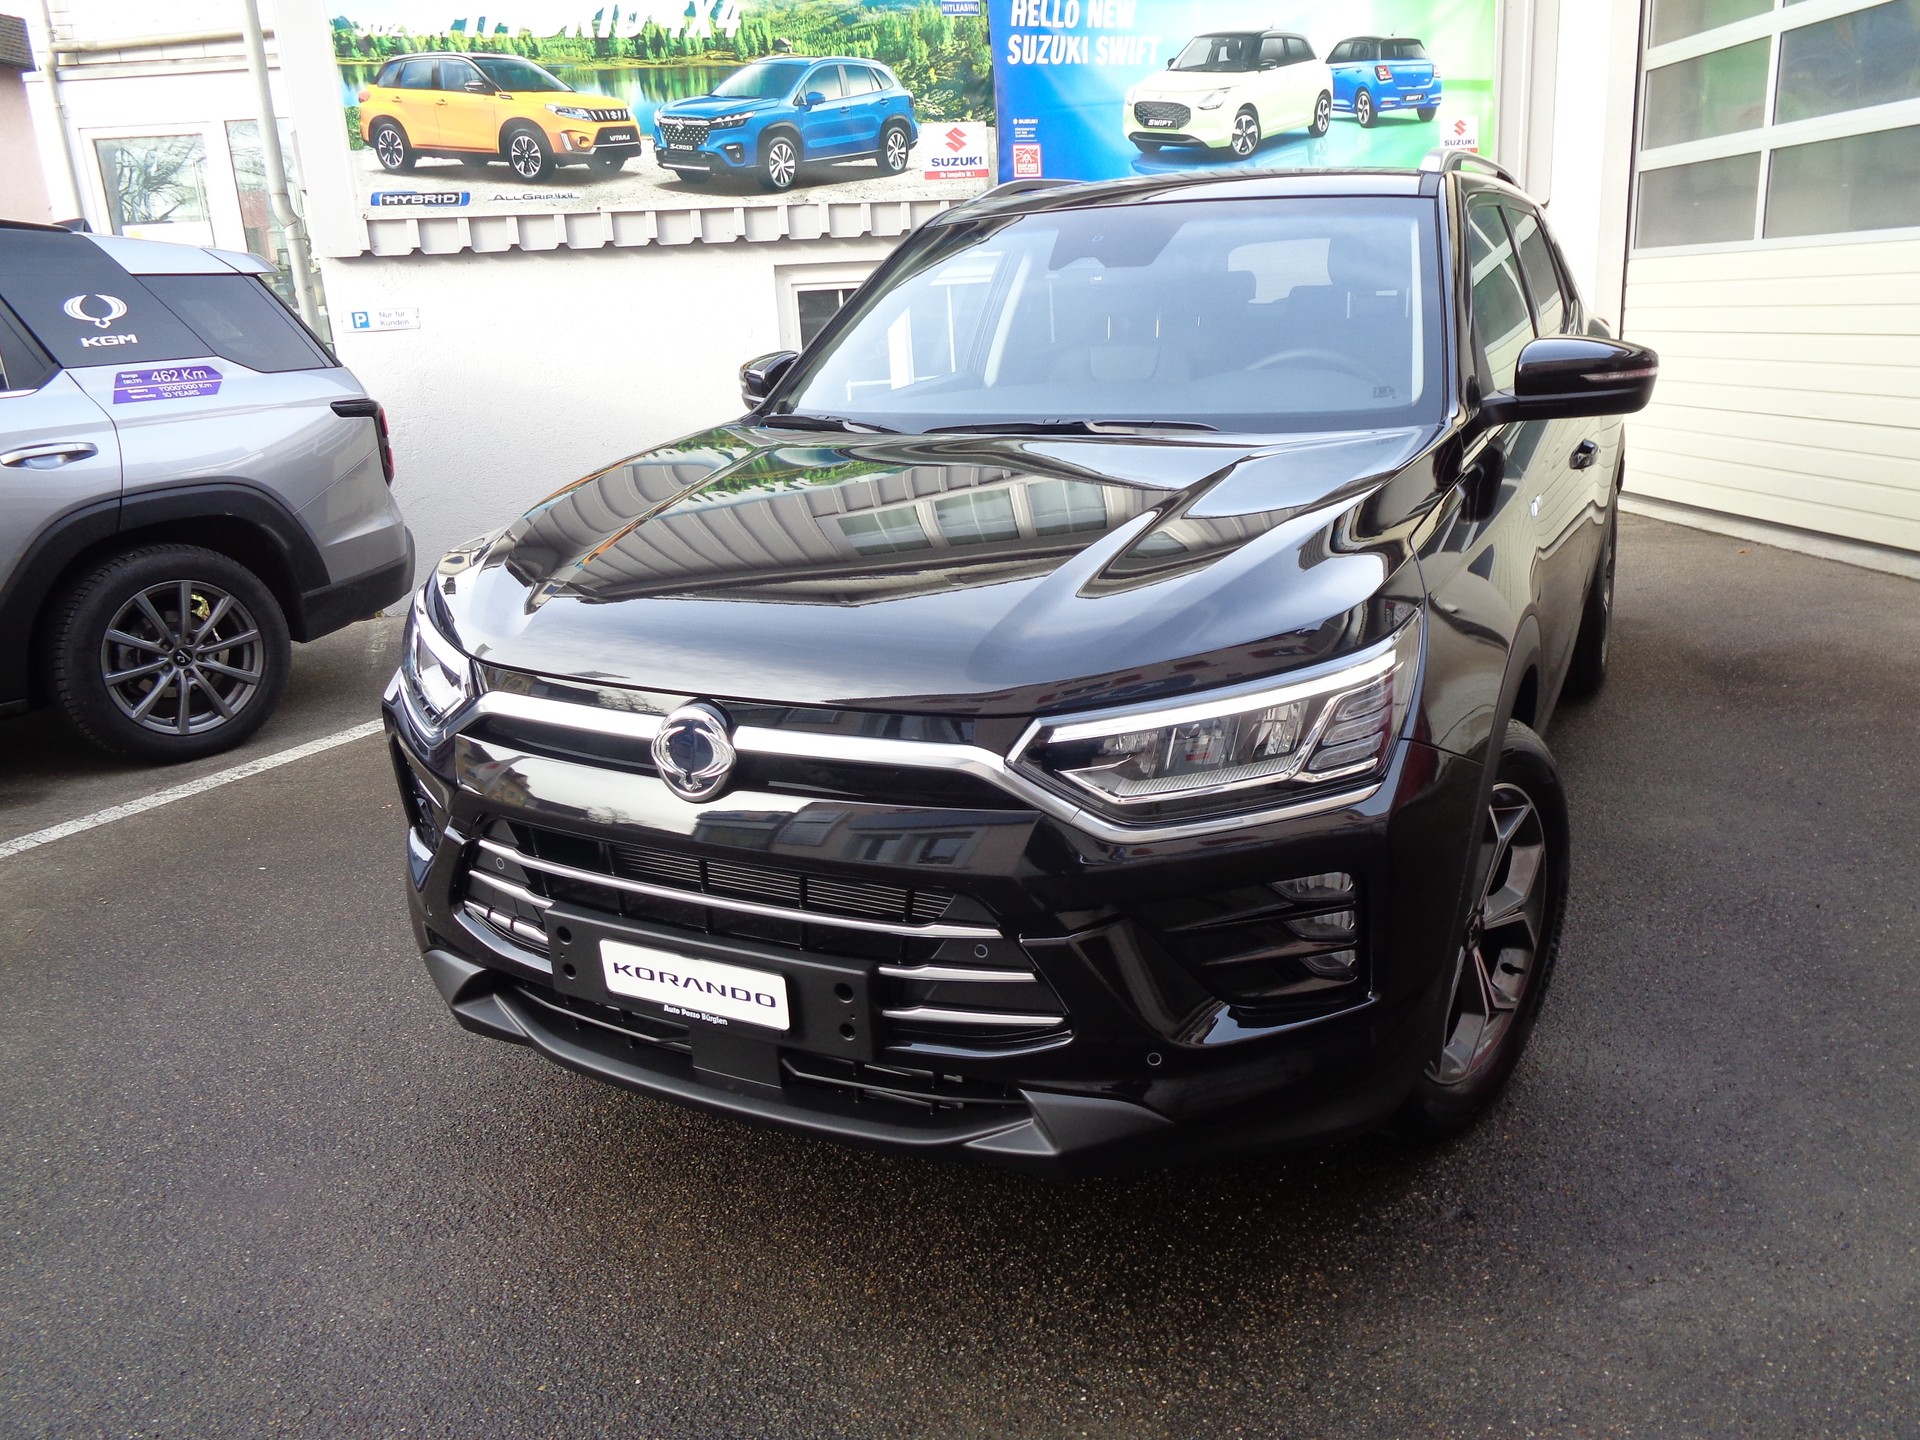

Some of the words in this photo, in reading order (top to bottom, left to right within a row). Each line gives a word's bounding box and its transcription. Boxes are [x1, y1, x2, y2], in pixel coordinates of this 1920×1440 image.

[1011, 0, 1080, 28] HELLO
[1087, 0, 1136, 28] NEW
[1007, 34, 1089, 65] SUZUKI
[1095, 35, 1162, 66] SWIFT
[1148, 119, 1173, 127] SWIFT
[669, 143, 693, 151] S-CROSS
[1444, 139, 1475, 147] SUZUKI
[931, 156, 982, 167] SUZUKI
[385, 193, 456, 204] HYBRID
[354, 313, 367, 328] P
[380, 319, 410, 327] Kunden
[81, 334, 138, 348] KGM
[151, 369, 180, 383] 462
[181, 368, 208, 380] Km
[172, 390, 200, 398] YEARS
[613, 962, 776, 1008] KORANDO
[663, 1004, 681, 1015] Auto
